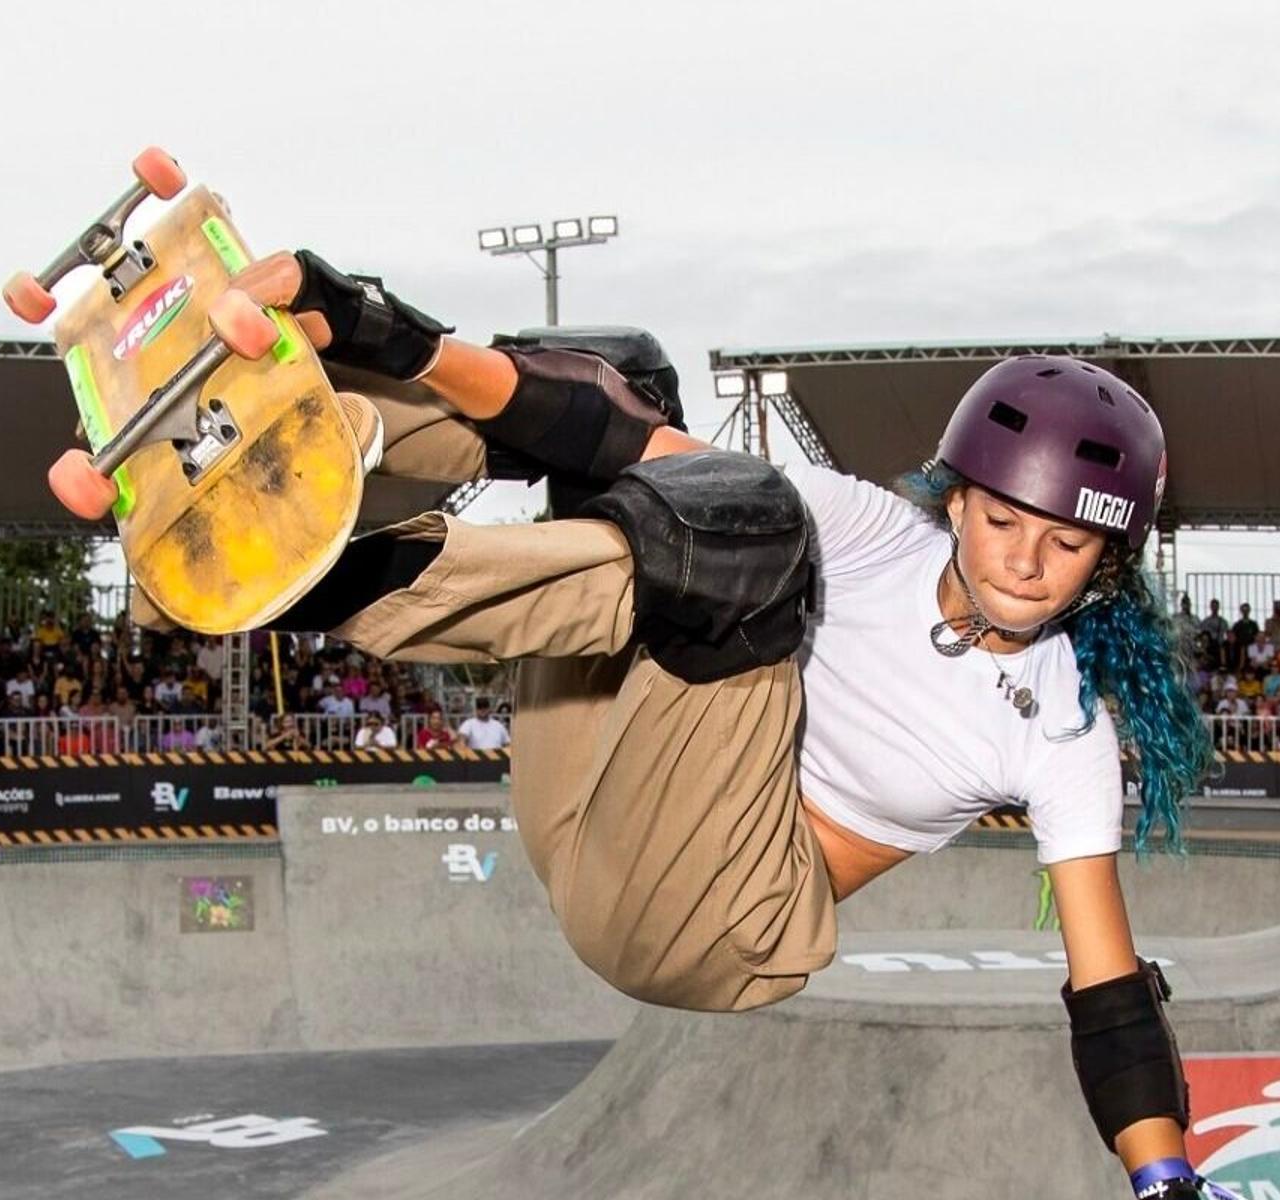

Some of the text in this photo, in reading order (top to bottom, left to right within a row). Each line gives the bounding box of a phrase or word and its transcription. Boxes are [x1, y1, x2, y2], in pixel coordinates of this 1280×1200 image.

[113, 274, 194, 360] FRUK
[1075, 487, 1135, 531] NIGGLI
[321, 816, 358, 835] BV,
[363, 818, 379, 832] o
[385, 814, 459, 832] banco
[464, 814, 495, 831] do
